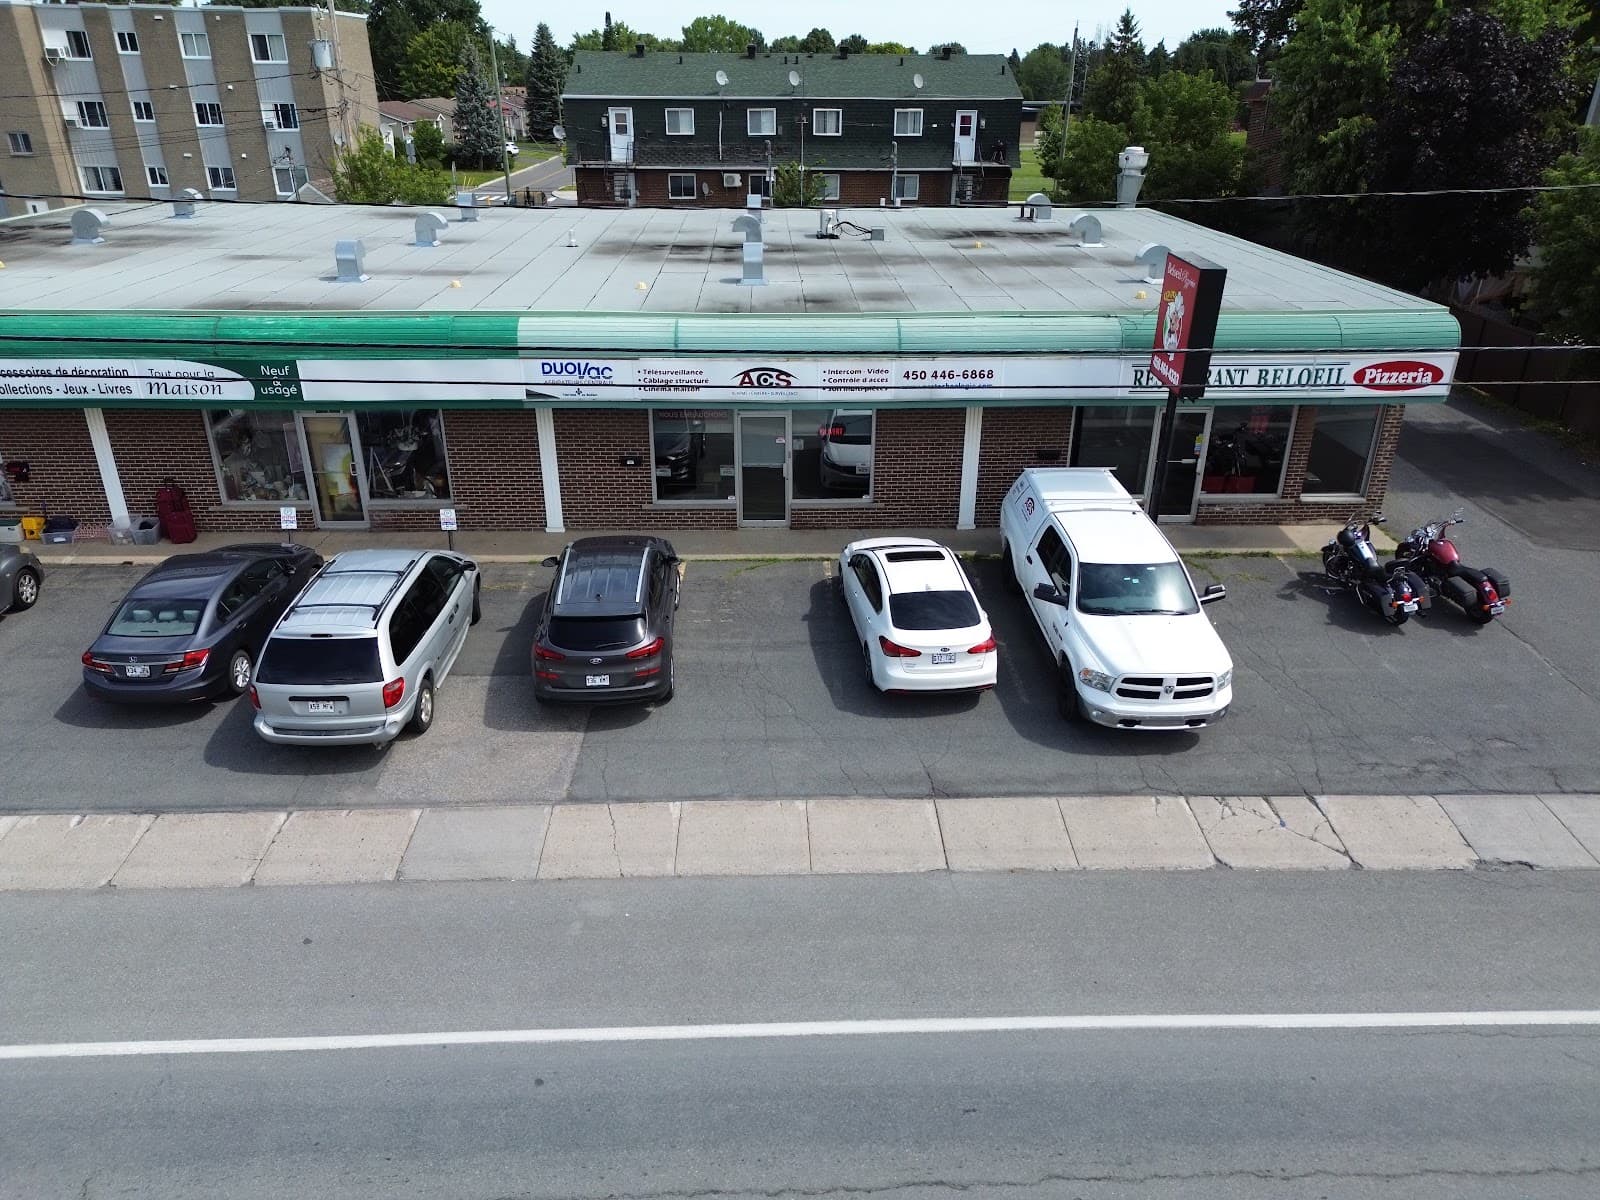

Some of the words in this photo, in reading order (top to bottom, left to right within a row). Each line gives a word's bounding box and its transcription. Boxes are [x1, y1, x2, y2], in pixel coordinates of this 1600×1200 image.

[55, 366, 68, 377] de
[71, 366, 129, 378] décoration
[261, 365, 290, 376] Neuf
[903, 370, 927, 380] 450
[931, 370, 994, 380] 446-6868
[1257, 368, 1347, 386] BELOEIL
[1363, 367, 1433, 385] Pizzeria
[738, 371, 792, 387] ACS
[0, 383, 53, 395] ollections
[63, 384, 89, 395] Jeux
[99, 384, 133, 395] Livres
[146, 381, 224, 395] Maison
[261, 384, 298, 397] usagé
